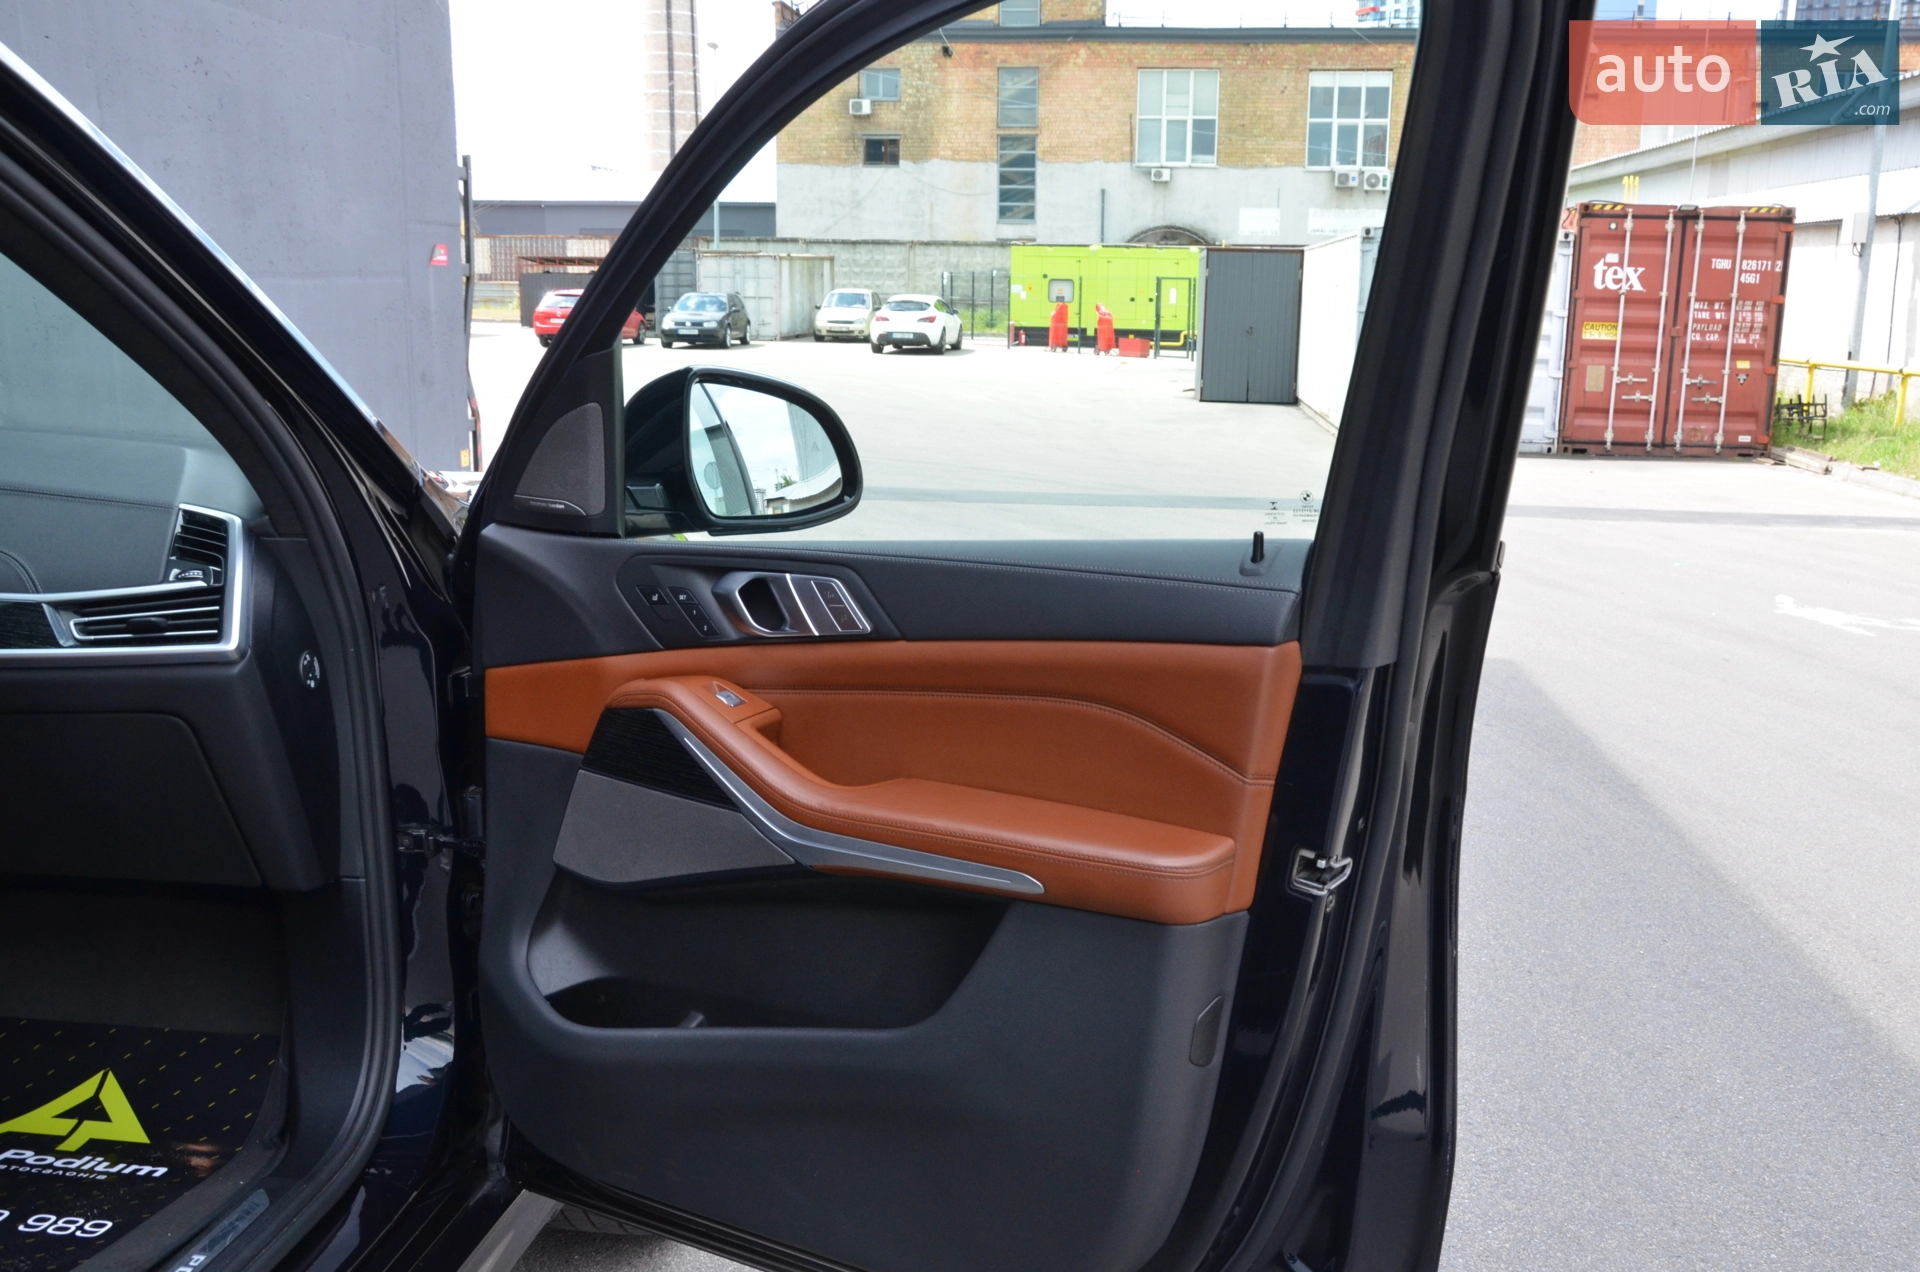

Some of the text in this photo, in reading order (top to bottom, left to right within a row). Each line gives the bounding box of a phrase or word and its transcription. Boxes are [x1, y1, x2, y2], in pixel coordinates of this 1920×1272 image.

[1711, 258, 1783, 272] TGHU 826171 2
[1593, 257, 1646, 291] tex
[1694, 311, 1727, 320] TARE WT.
[1584, 323, 1618, 331] CAUTION
[1692, 323, 1722, 332] PAYLOAD
[0, 1149, 168, 1177] Podium
[17, 1213, 113, 1238] 989
